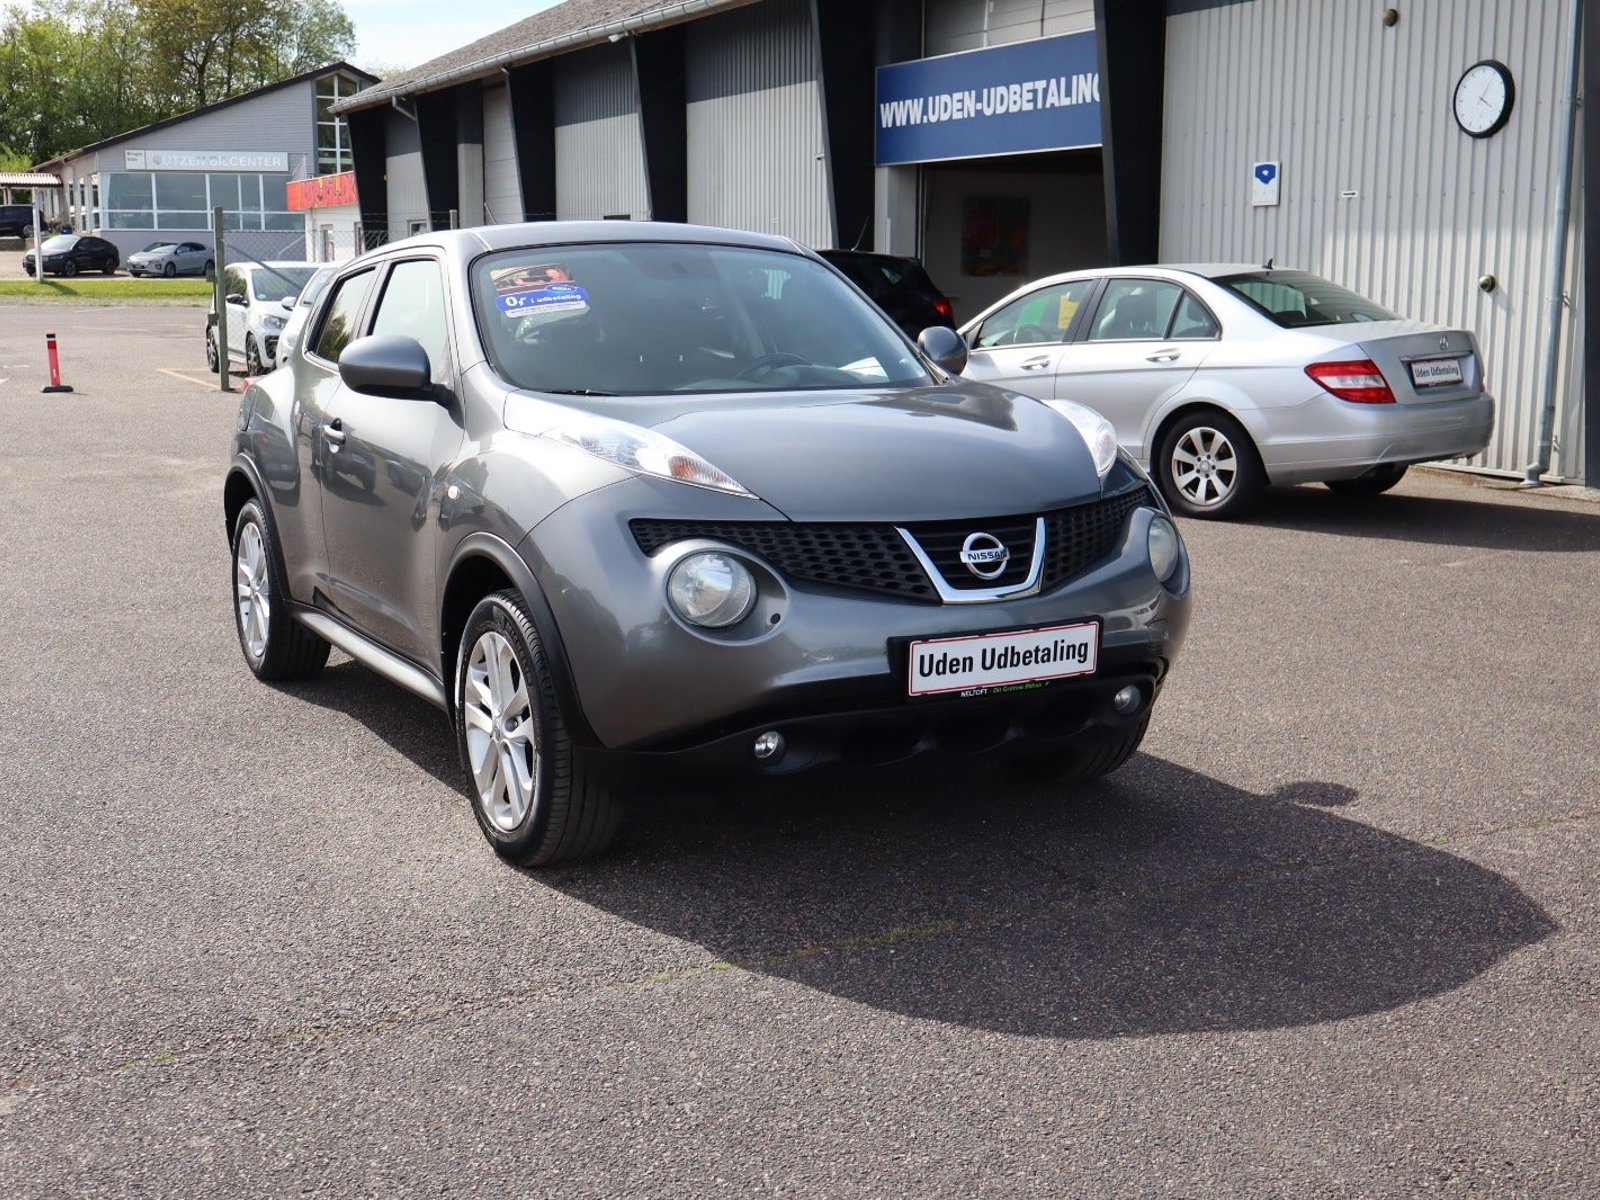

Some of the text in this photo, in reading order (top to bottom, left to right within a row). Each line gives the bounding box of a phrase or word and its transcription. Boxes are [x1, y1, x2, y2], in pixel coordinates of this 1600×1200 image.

[967, 549, 1007, 561] NISSAN
[919, 639, 1089, 678] Uden Udbetaling
